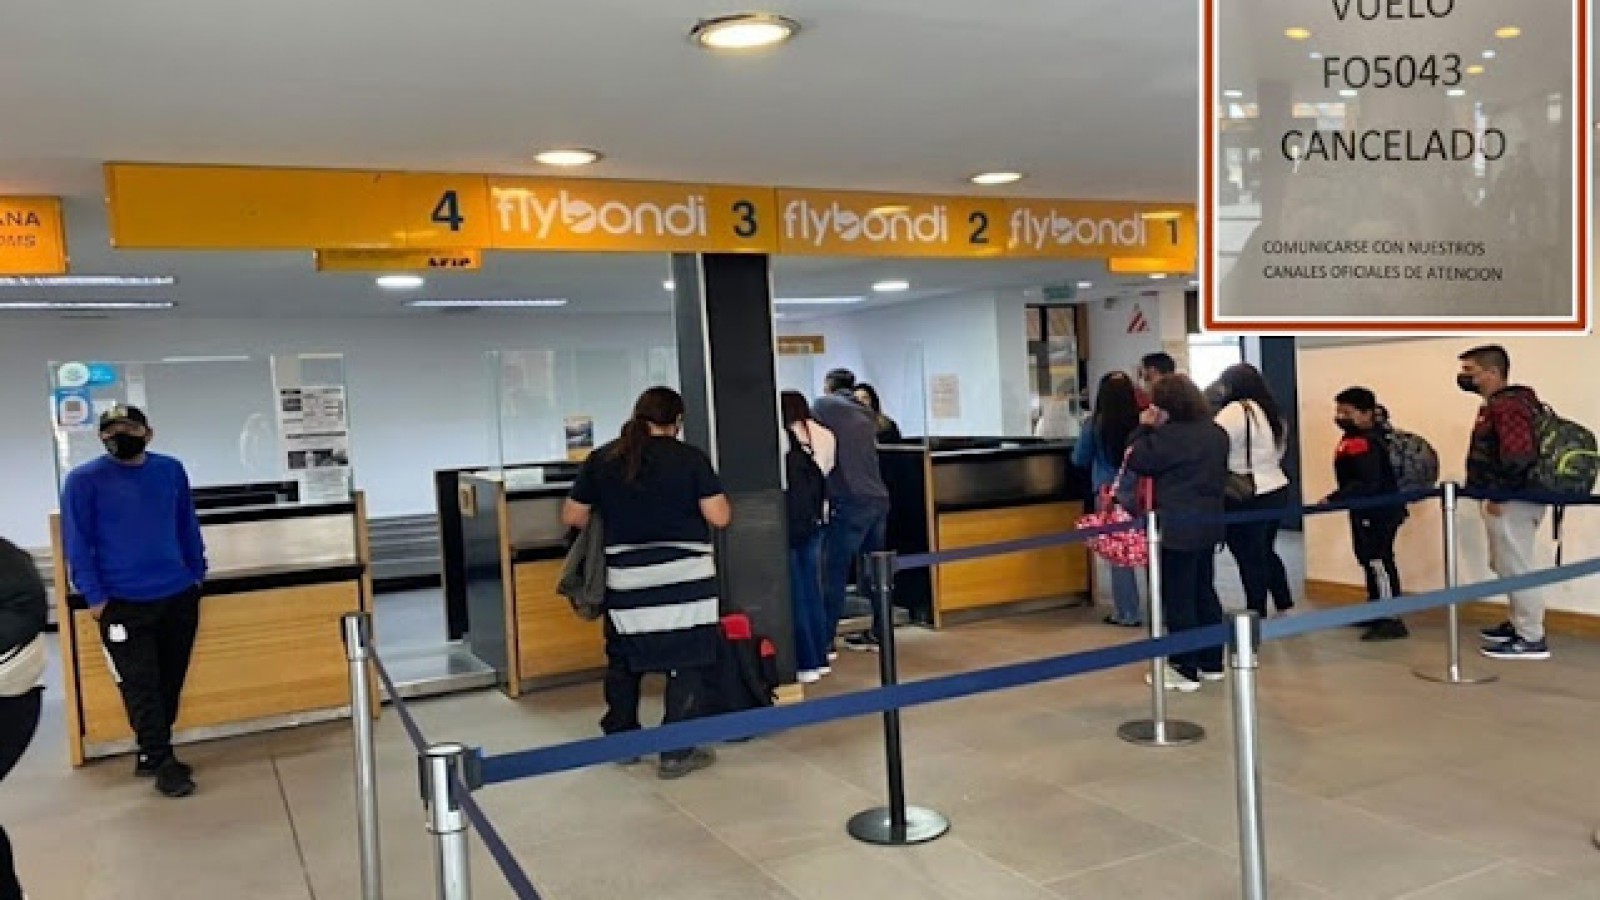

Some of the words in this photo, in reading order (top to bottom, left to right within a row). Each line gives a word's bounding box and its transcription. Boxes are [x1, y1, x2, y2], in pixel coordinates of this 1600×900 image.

[1322, 54, 1462, 88] FO5043
[1281, 128, 1506, 162] CANCELADO
[431, 190, 464, 231] 4
[492, 187, 707, 238] flybondi
[731, 200, 758, 237] 3
[784, 200, 949, 246] flybondi
[968, 211, 990, 244] 2
[1009, 208, 1146, 248] flybondi
[1166, 219, 1178, 246] 1
[1263, 240, 1368, 254] COMUNICARSE
[1371, 240, 1403, 254] CON
[1407, 241, 1486, 256] NUESTROS
[1263, 265, 1328, 279] CANALES
[1330, 265, 1401, 280] OFICIALES
[1404, 265, 1423, 280] DE
[1426, 266, 1503, 281] ATENCION
